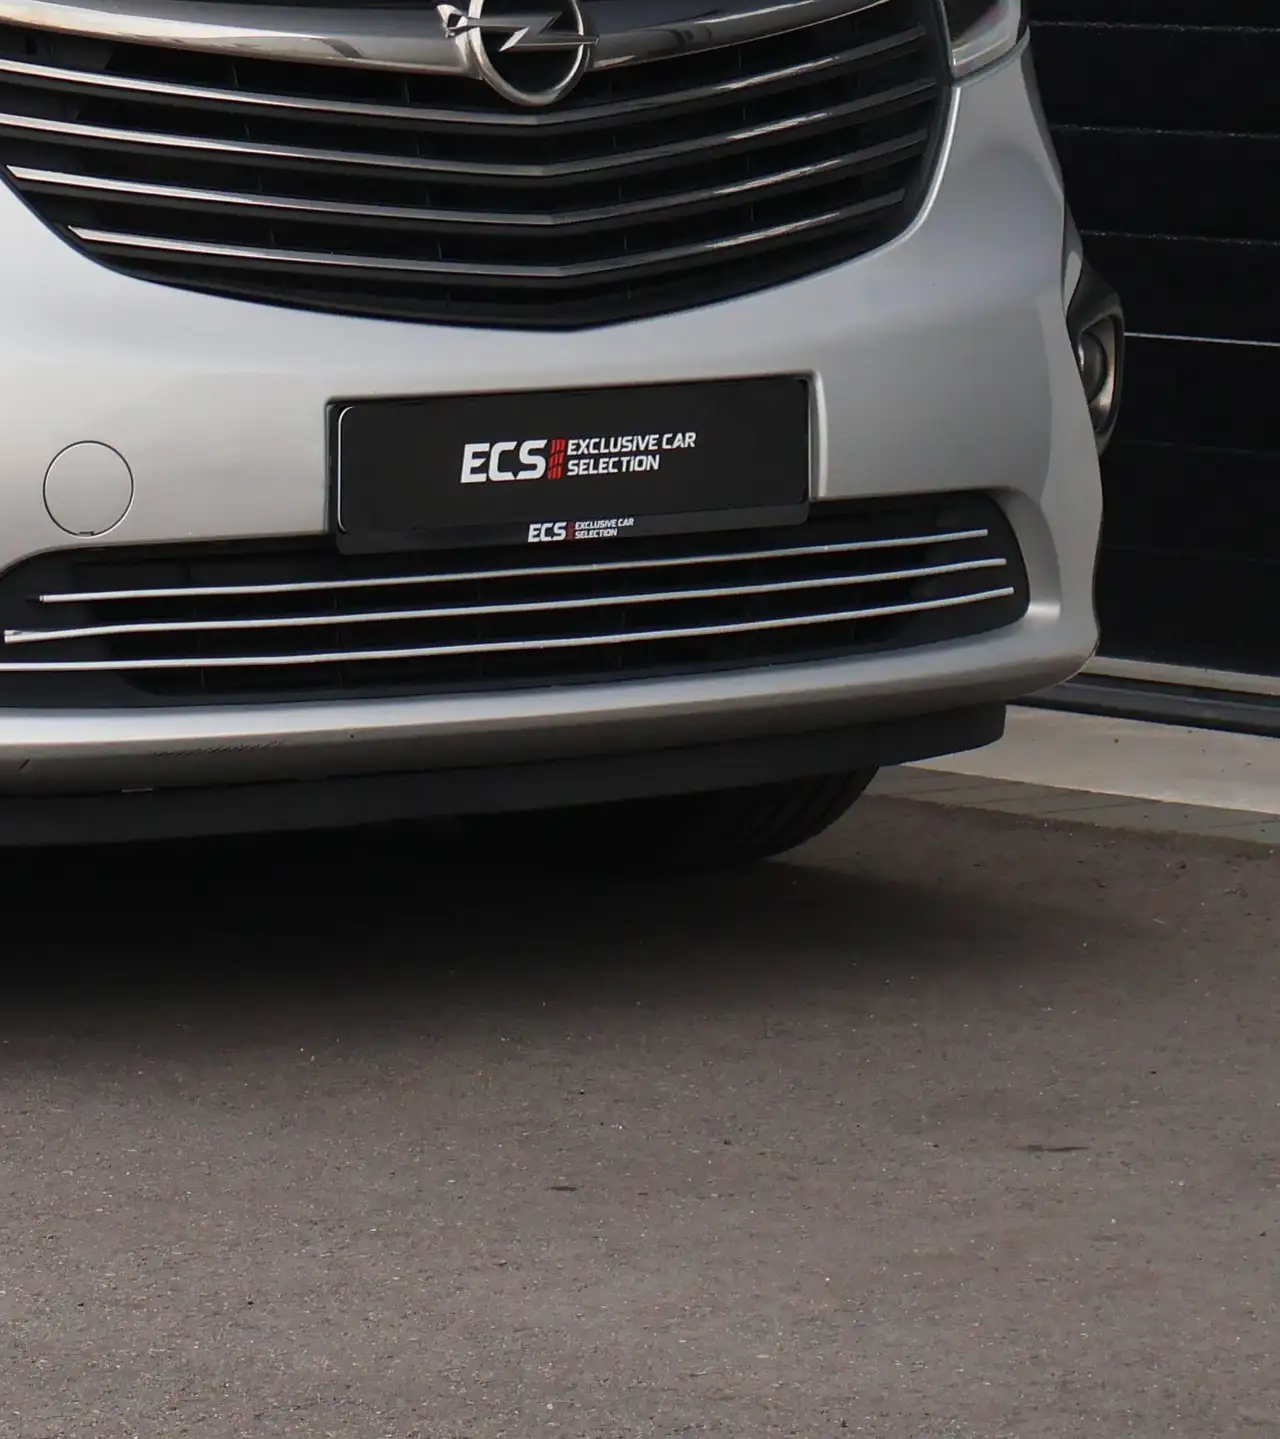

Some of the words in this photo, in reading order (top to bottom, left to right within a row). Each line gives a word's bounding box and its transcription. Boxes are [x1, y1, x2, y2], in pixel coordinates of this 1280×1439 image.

[566, 433, 659, 456] EXCLUSIVE
[661, 431, 697, 450] CAR
[460, 439, 548, 484] ECS
[566, 453, 660, 476] SELECTION
[527, 521, 567, 543] ECS
[574, 518, 617, 530] EXCLUSIVE
[617, 517, 635, 528] CAR
[574, 527, 618, 540] SELECTION
